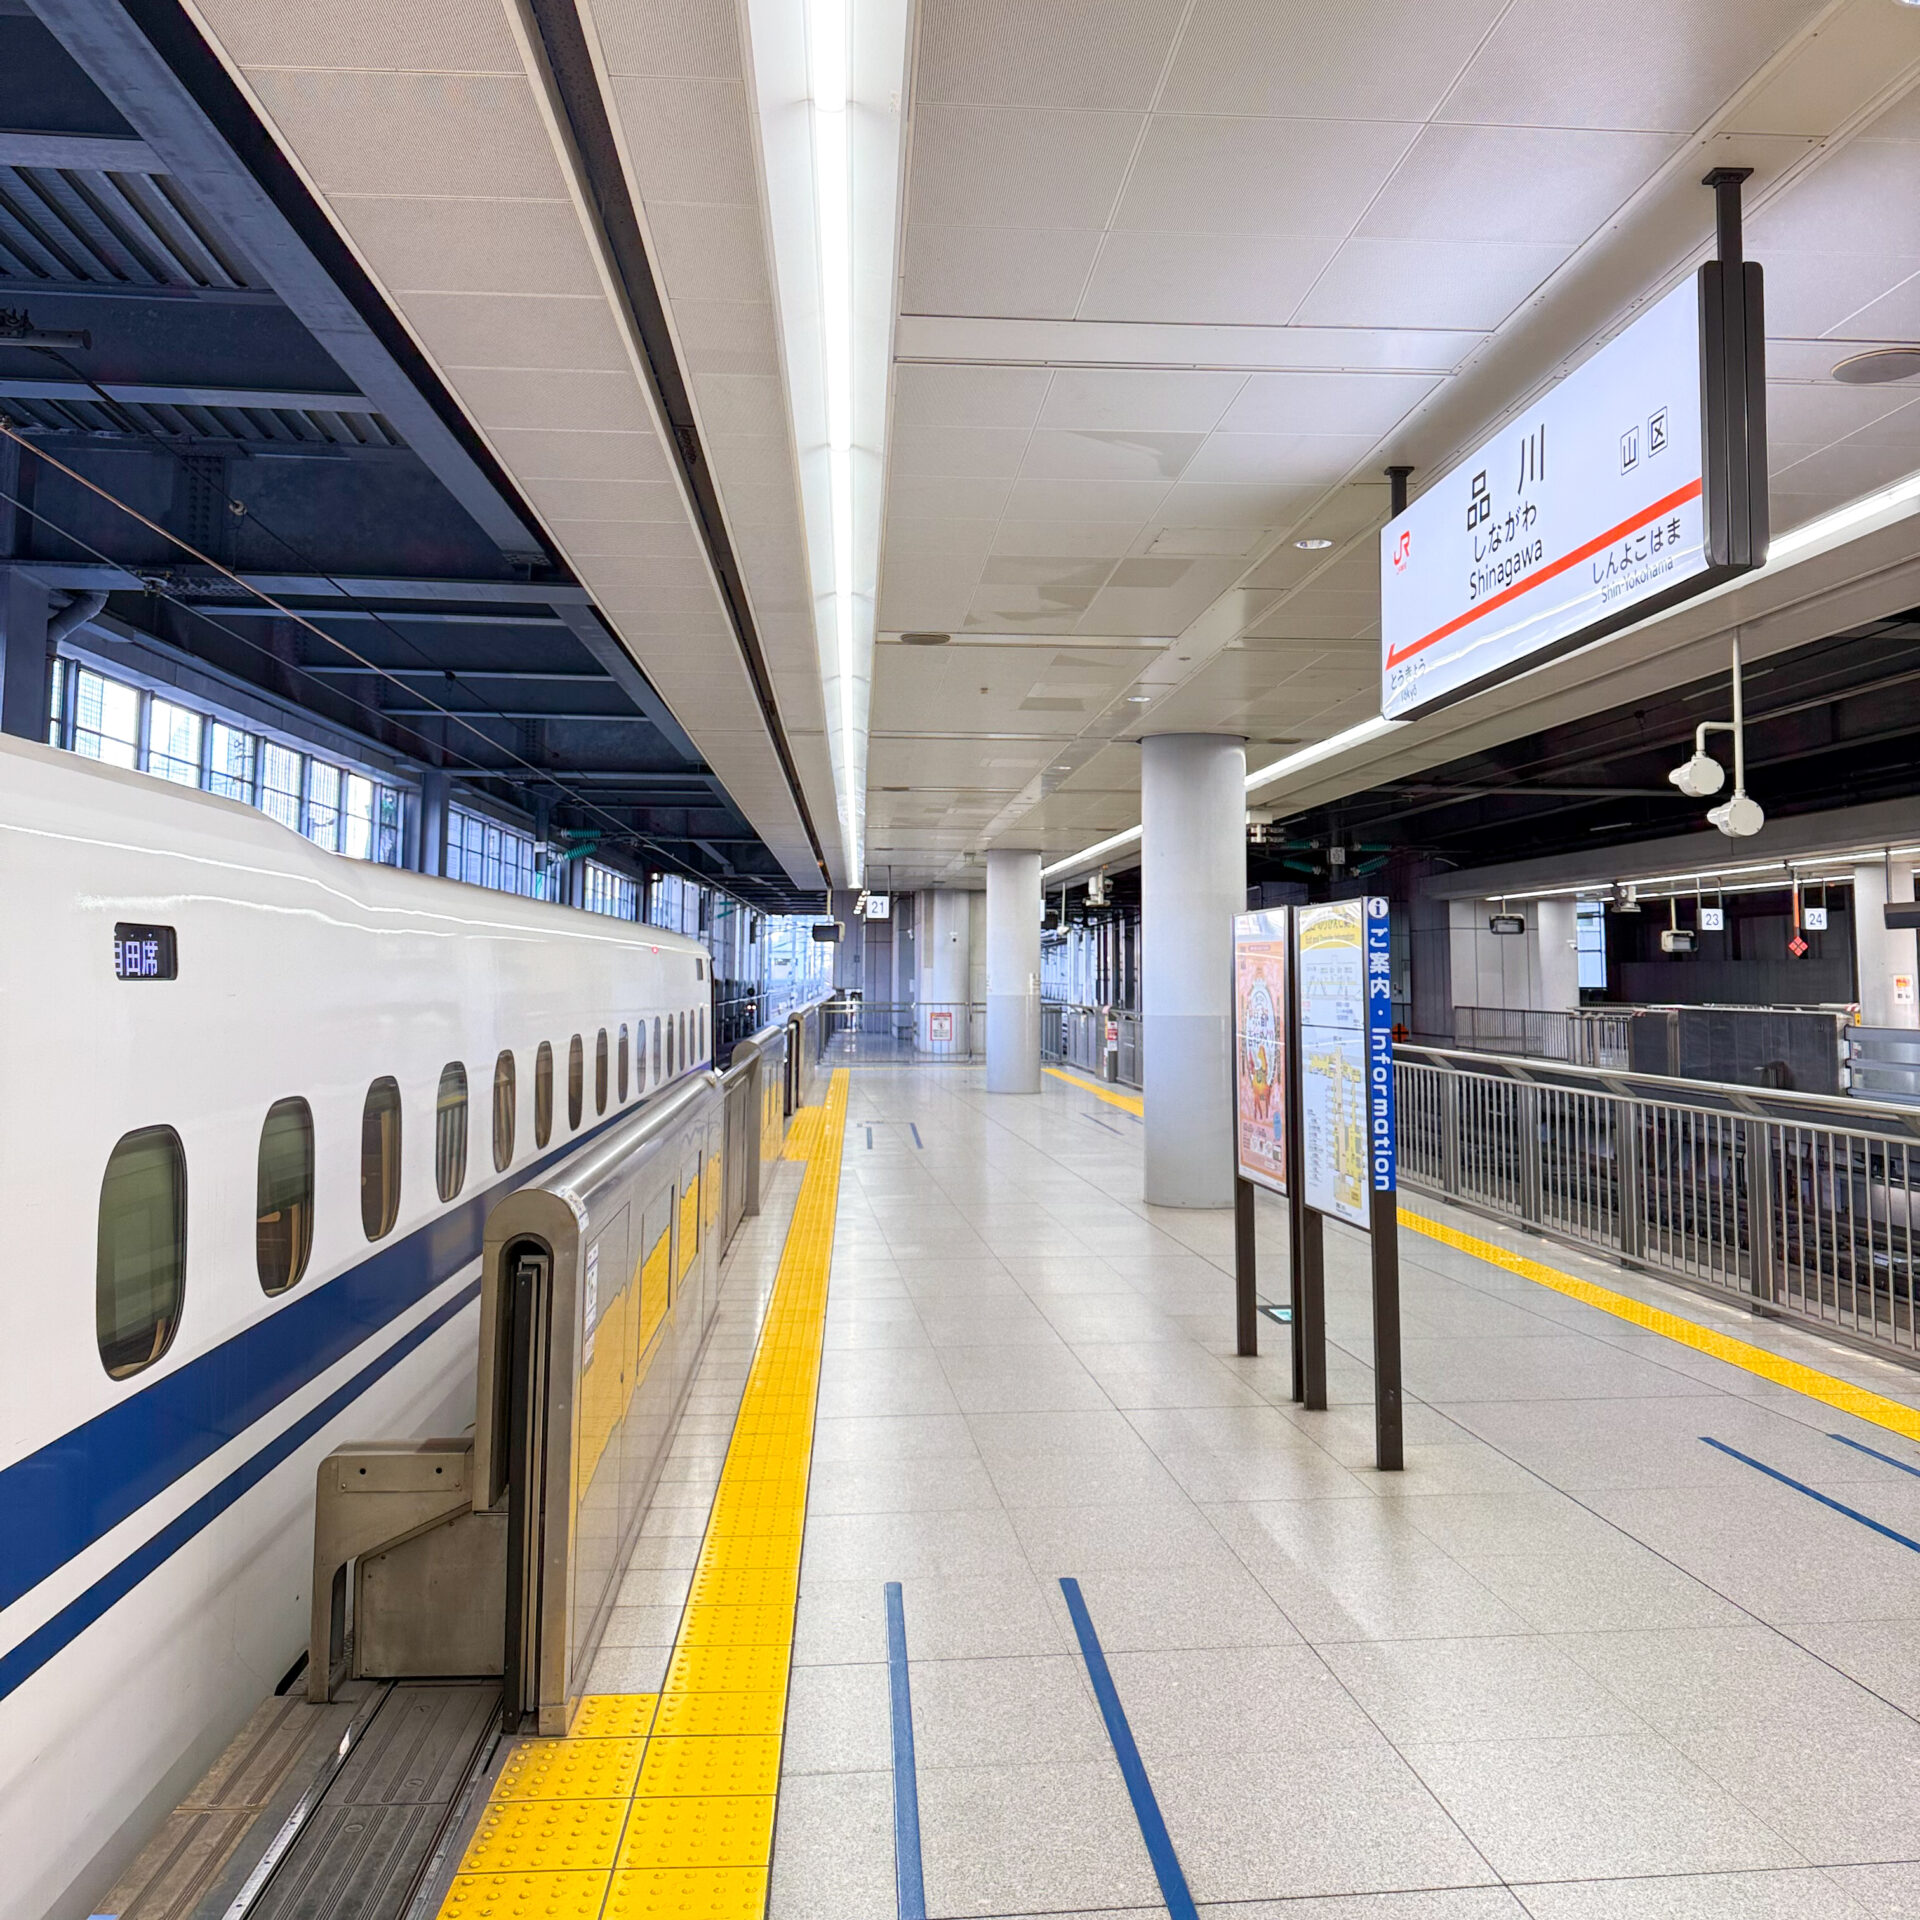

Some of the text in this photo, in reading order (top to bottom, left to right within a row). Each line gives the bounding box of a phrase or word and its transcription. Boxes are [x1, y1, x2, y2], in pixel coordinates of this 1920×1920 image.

[1393, 530, 1410, 565] JR
[1474, 500, 1537, 563] しながわ
[1593, 517, 1680, 584] しんよこはま
[1470, 538, 1543, 600] Shinagawa
[1601, 556, 1673, 603] Shin-Yokohama
[1391, 658, 1426, 690] とうきょう
[871, 900, 884, 913] 21
[1705, 913, 1719, 926] 23
[1809, 913, 1822, 926] 24
[1371, 1027, 1392, 1191] Information
